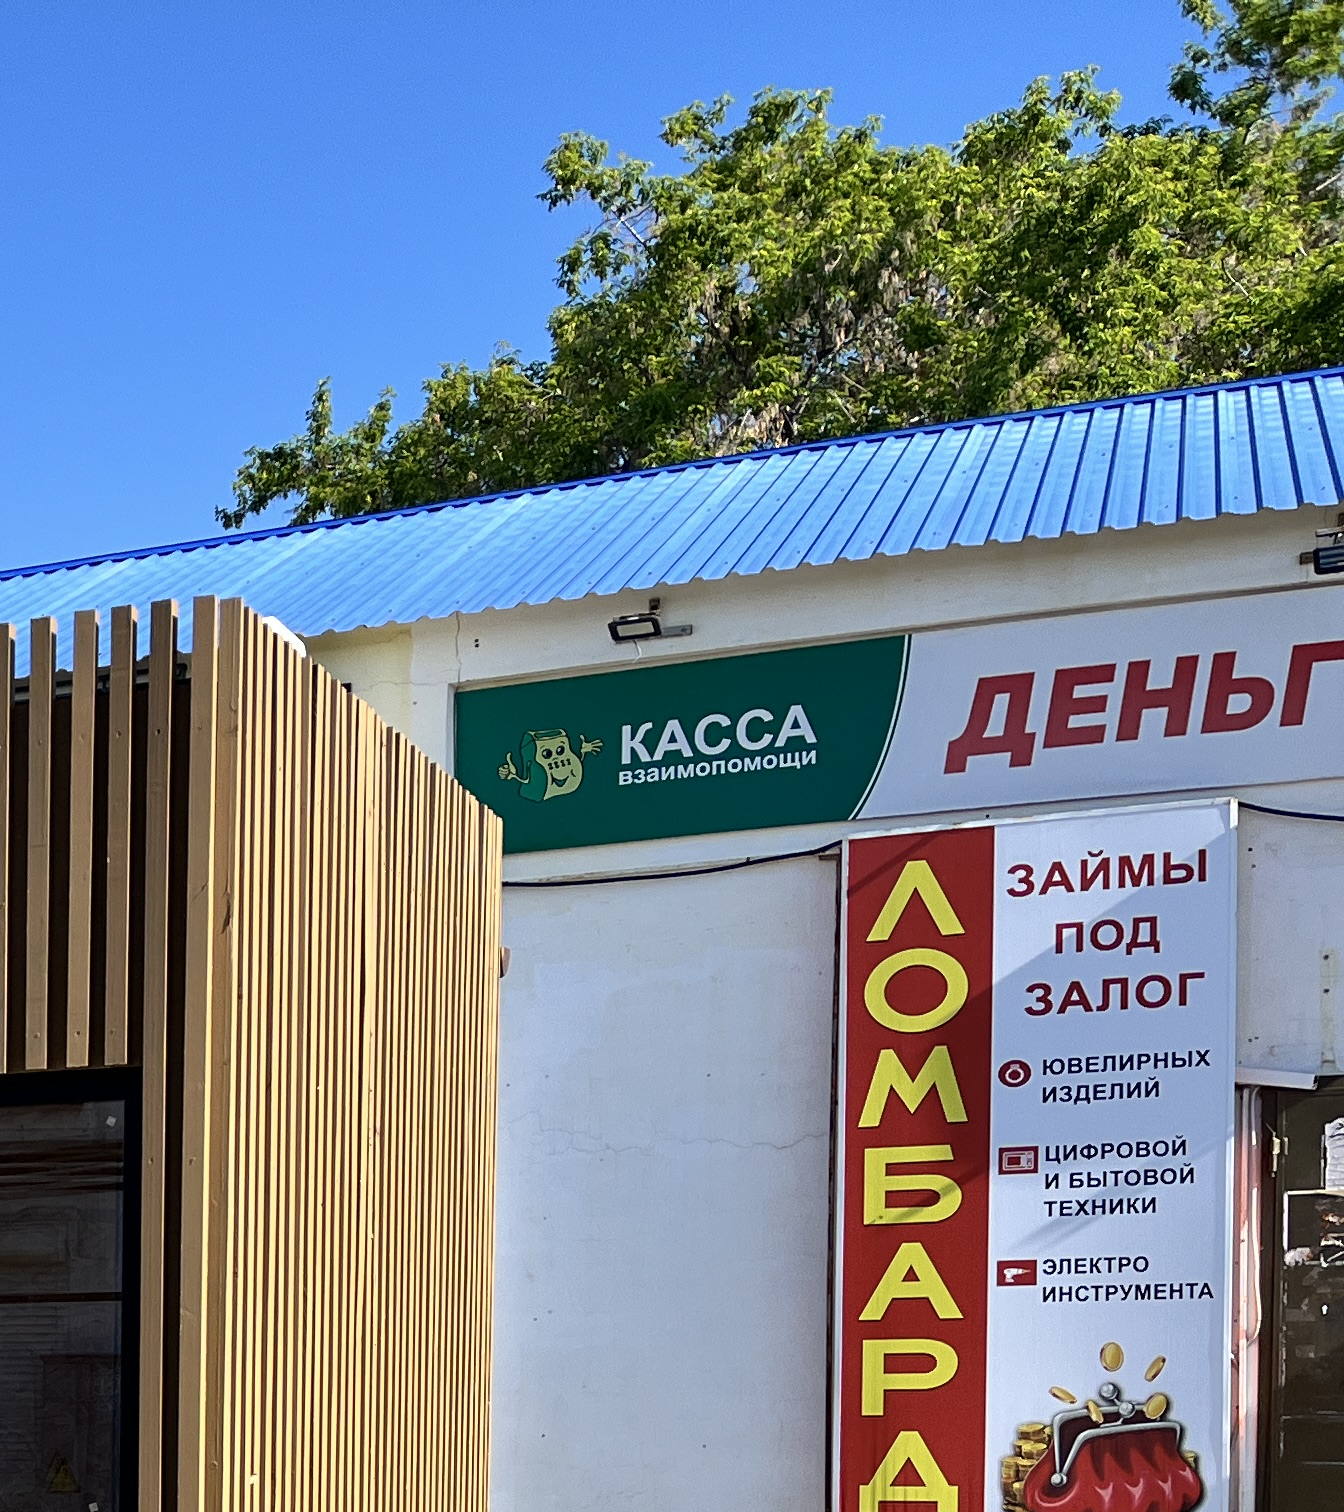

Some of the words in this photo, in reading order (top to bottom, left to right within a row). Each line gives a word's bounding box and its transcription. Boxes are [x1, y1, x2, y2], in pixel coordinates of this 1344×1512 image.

[944, 640, 1344, 774] ДЕНЬГ
[621, 704, 817, 765] КАССА
[618, 749, 816, 785] взаимопомощи
[1006, 848, 1207, 897] ЗАЙМЫ
[1055, 915, 1161, 955] ПОД
[1024, 972, 1205, 1016] ЗАЛОГ
[1042, 1049, 1211, 1076] ЮВЕЛИРНЫХ
[1042, 1076, 1160, 1104] ИЗДЕЛИЙ
[1045, 1135, 1187, 1164] ЦИФРОВОЙ
[1044, 1173, 1059, 1189] И
[1069, 1162, 1194, 1188] БЫТОВОЙ
[1044, 1197, 1156, 1217] ТЕХНИКИ
[1042, 1256, 1149, 1275] ЭЛЕКТРО
[1042, 1283, 1214, 1302] ИНСТРУМЕНТА
